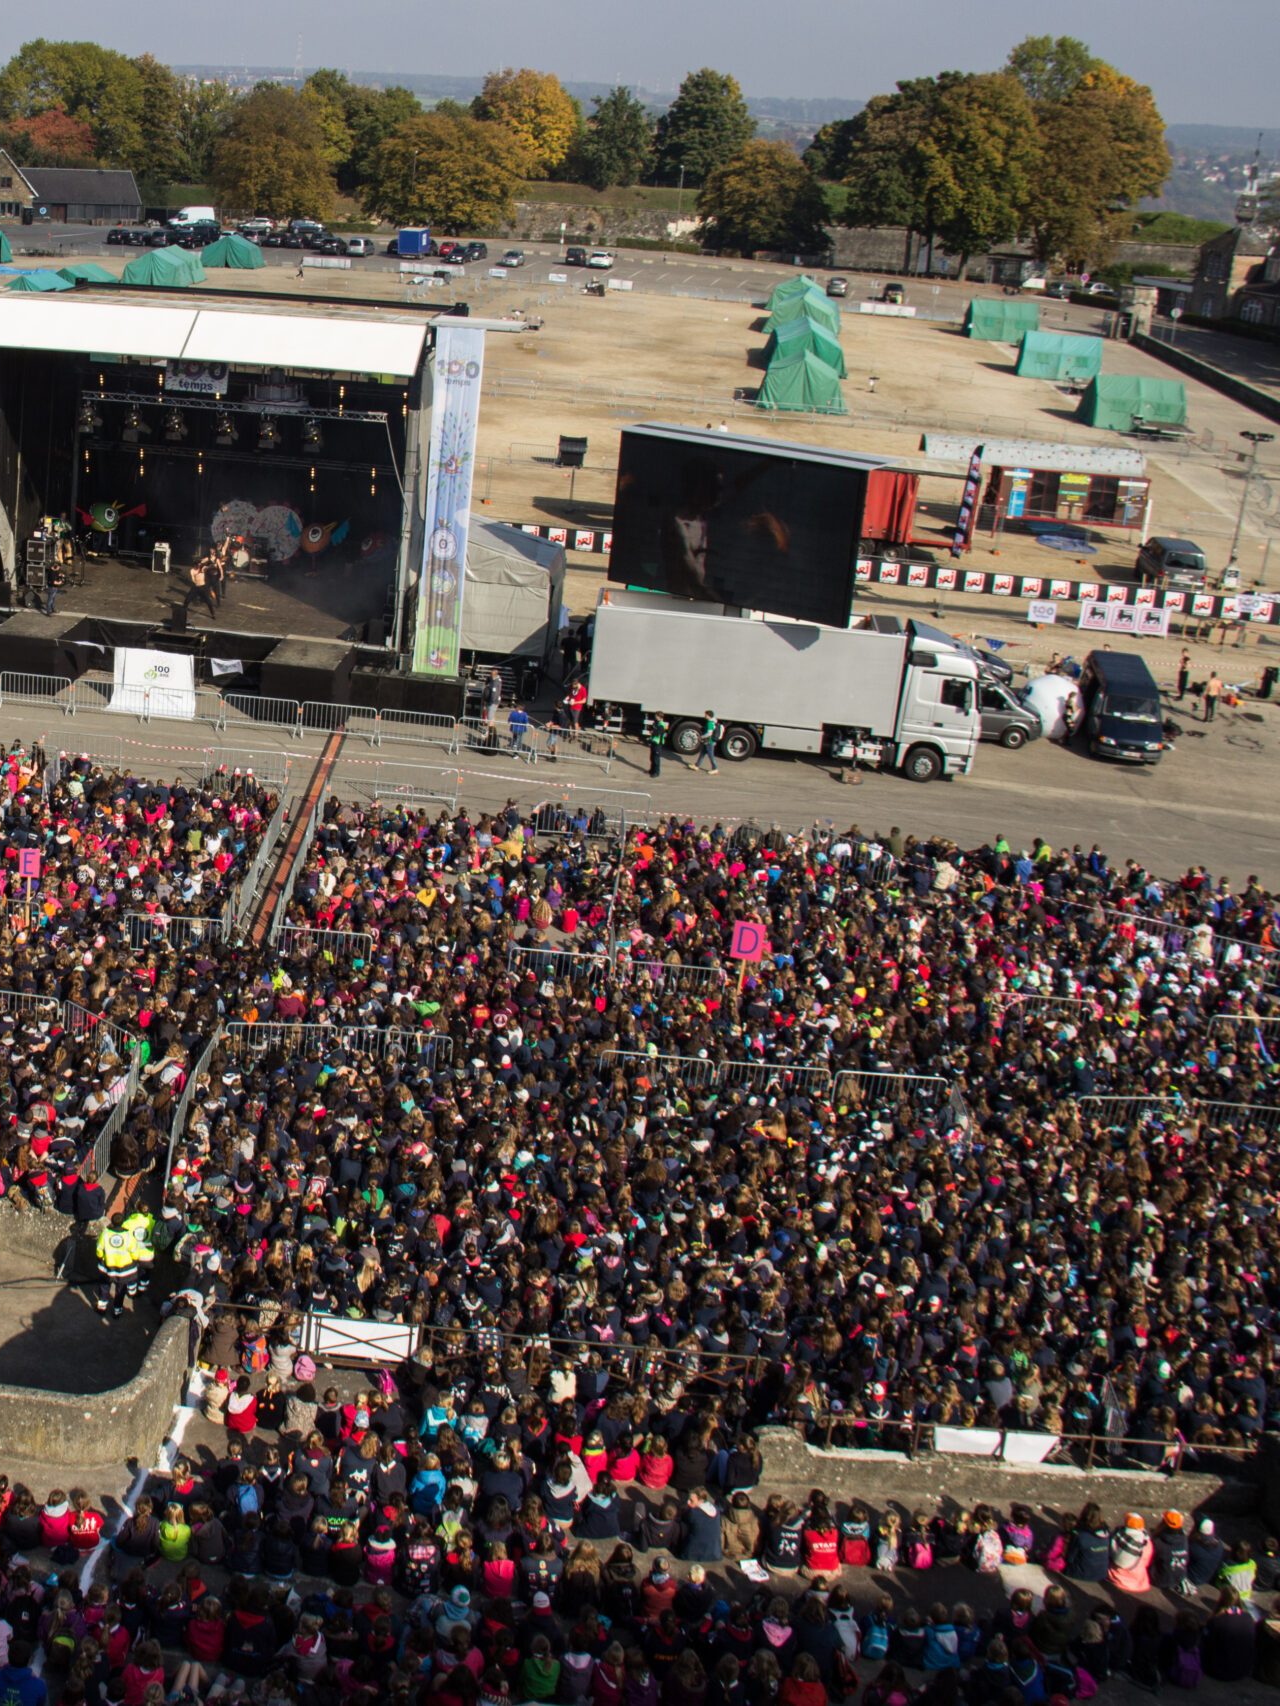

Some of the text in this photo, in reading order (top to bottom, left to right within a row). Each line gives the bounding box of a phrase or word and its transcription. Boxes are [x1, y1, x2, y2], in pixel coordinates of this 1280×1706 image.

[179, 380, 213, 391] temps
[23, 852, 36, 875] E
[737, 926, 759, 954] D
